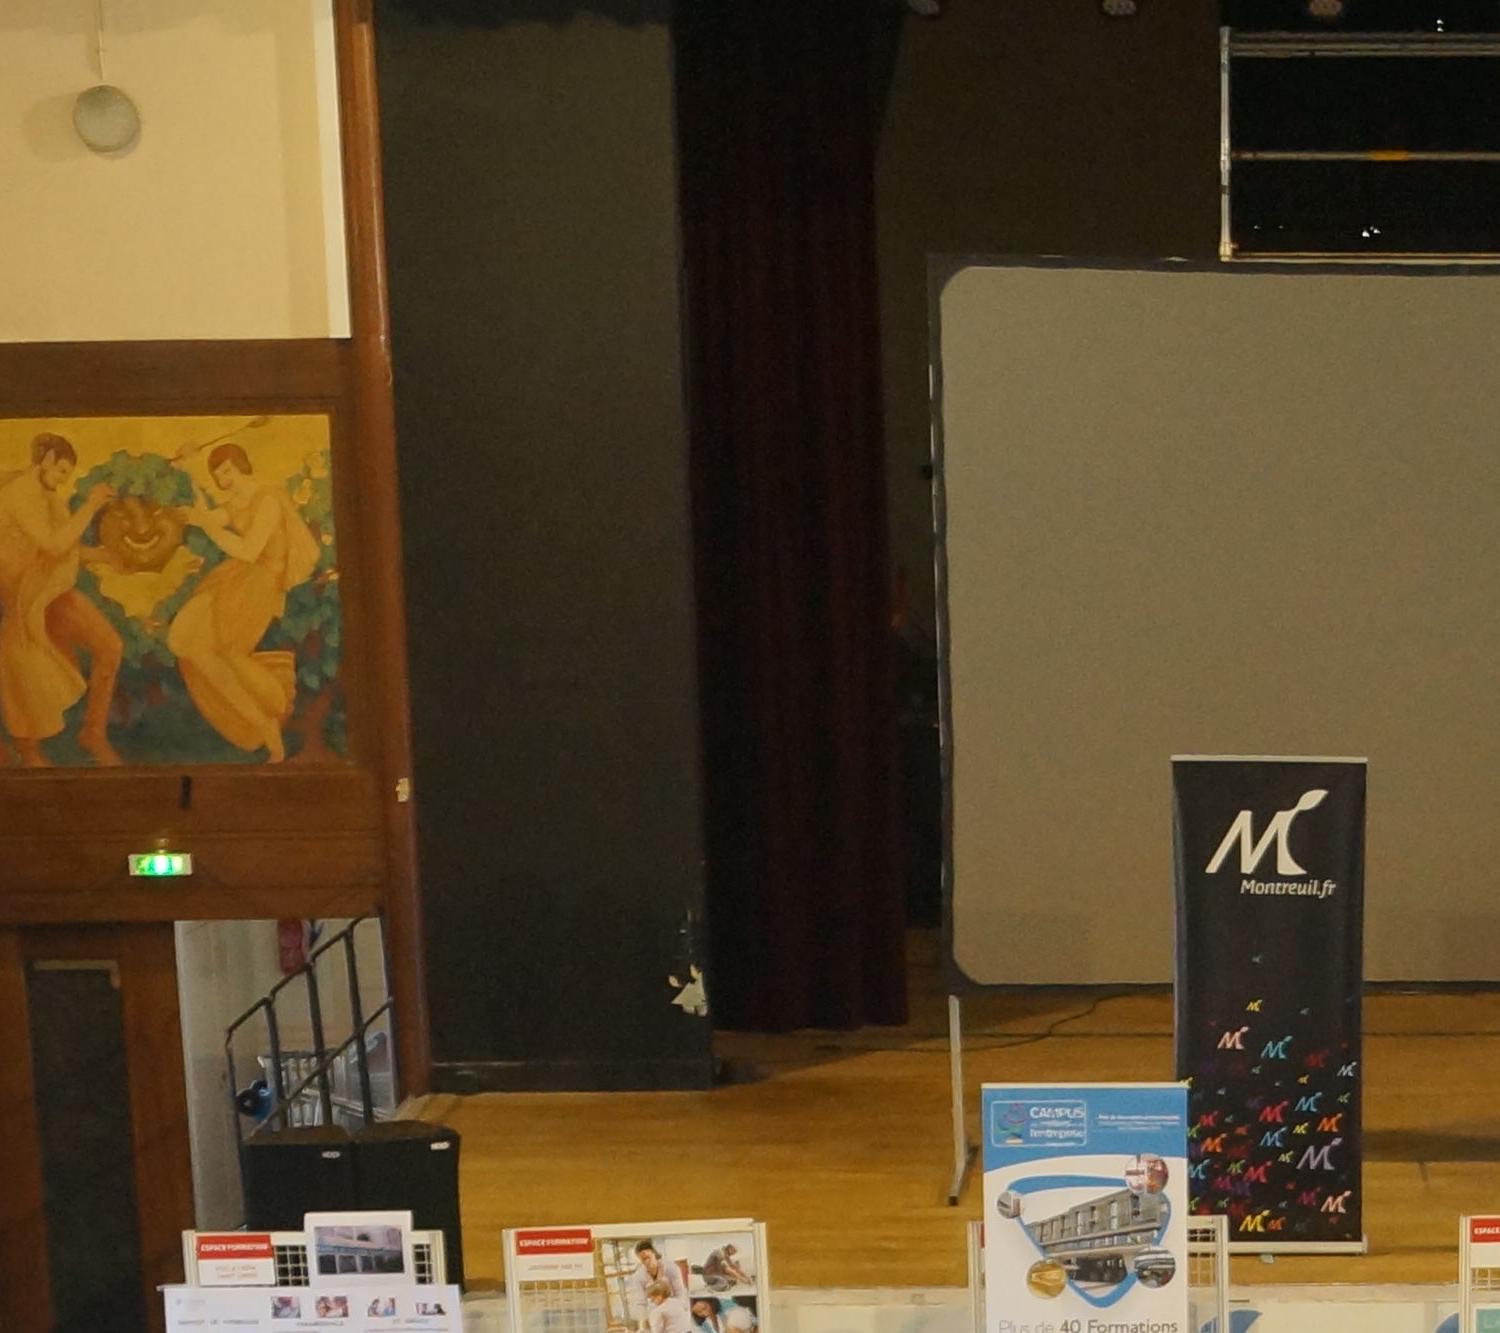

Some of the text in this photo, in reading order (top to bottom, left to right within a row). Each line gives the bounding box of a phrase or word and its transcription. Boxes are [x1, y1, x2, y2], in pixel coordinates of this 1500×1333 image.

[1240, 879, 1336, 898] Montreuil.fr
[1029, 1106, 1085, 1119] CAMPUS
[1034, 1319, 1054, 1333] de
[1059, 1319, 1082, 1333] 40
